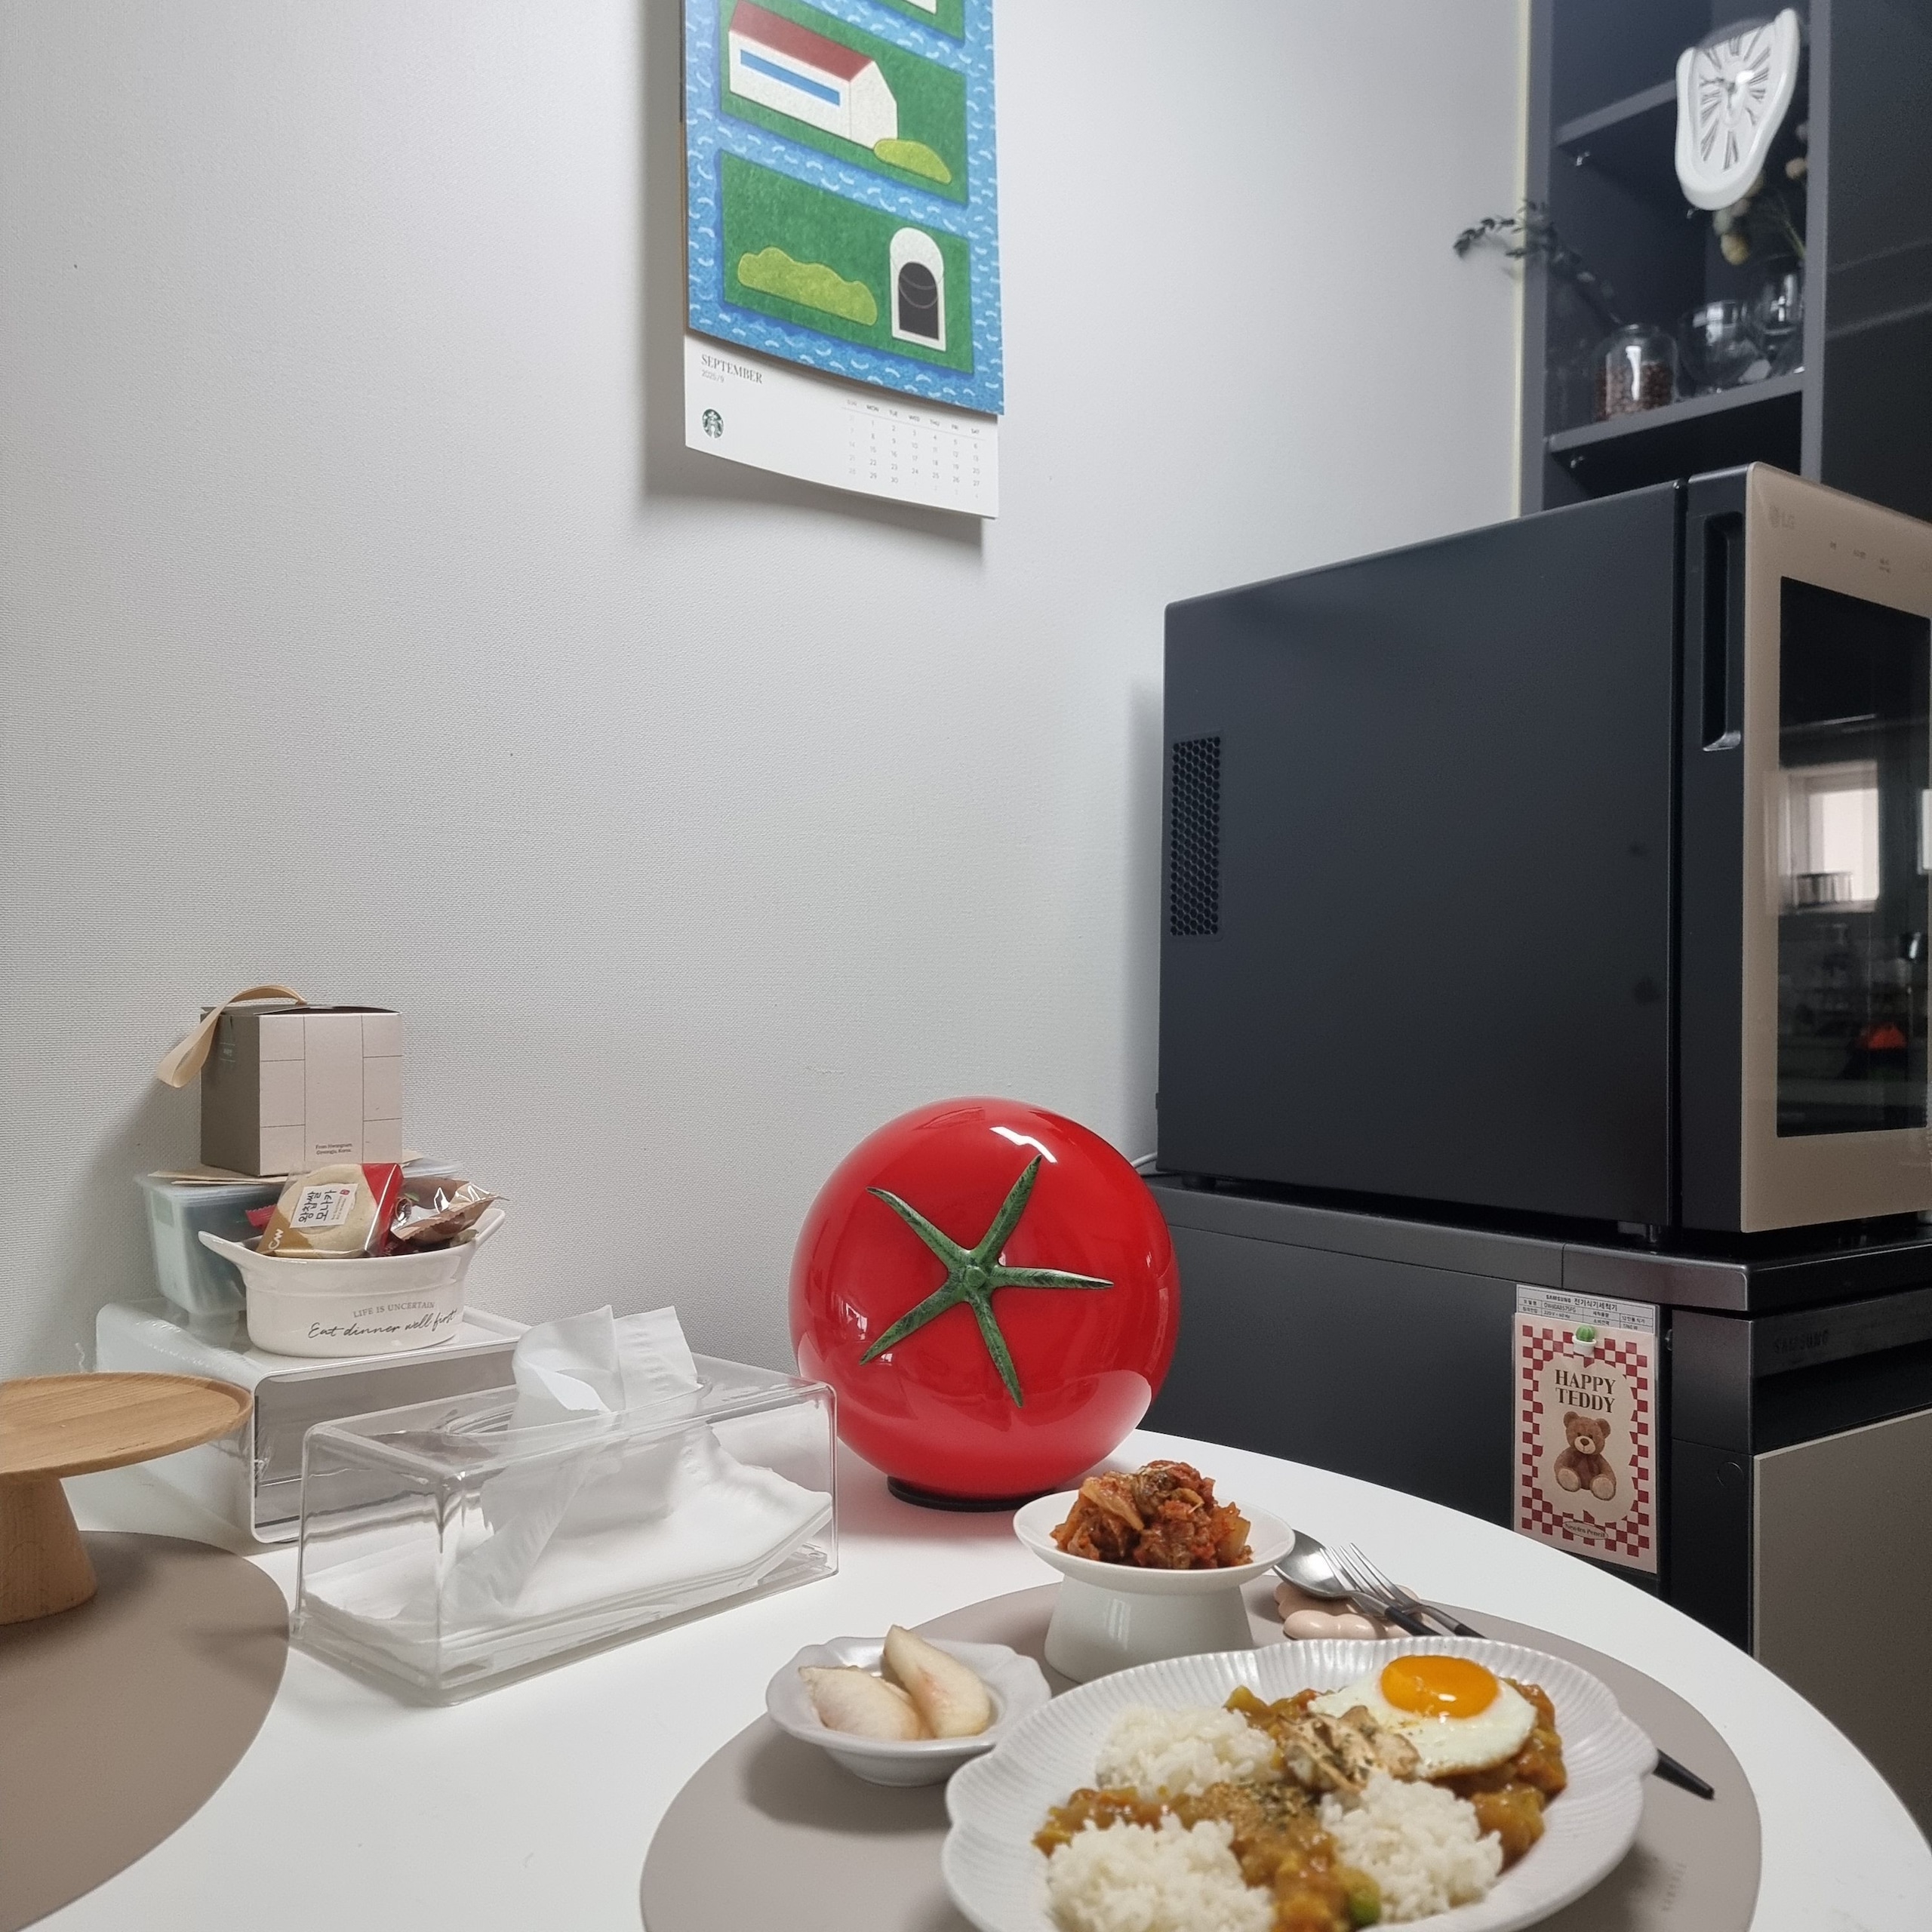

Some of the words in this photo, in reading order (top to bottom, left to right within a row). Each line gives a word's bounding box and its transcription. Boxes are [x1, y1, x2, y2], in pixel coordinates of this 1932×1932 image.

[701, 354, 763, 384] SEPTEMBER
[298, 1191, 321, 1223] 왕찹쌀
[315, 1189, 337, 1221] 모나카
[353, 1307, 374, 1318] LIFE
[377, 1305, 386, 1314] IS
[388, 1301, 435, 1312] UNCERTAIN
[1546, 1294, 1571, 1303] SAMSUNG
[1574, 1298, 1617, 1312] 전기식기세척기
[308, 1321, 344, 1339] Eat
[343, 1322, 400, 1337] dinner
[405, 1312, 433, 1331] well
[432, 1308, 458, 1332] first
[1555, 1369, 1616, 1395] HAPPY
[1555, 1387, 1616, 1414] TEDDY
[1586, 1528, 1605, 1537] Pencil
